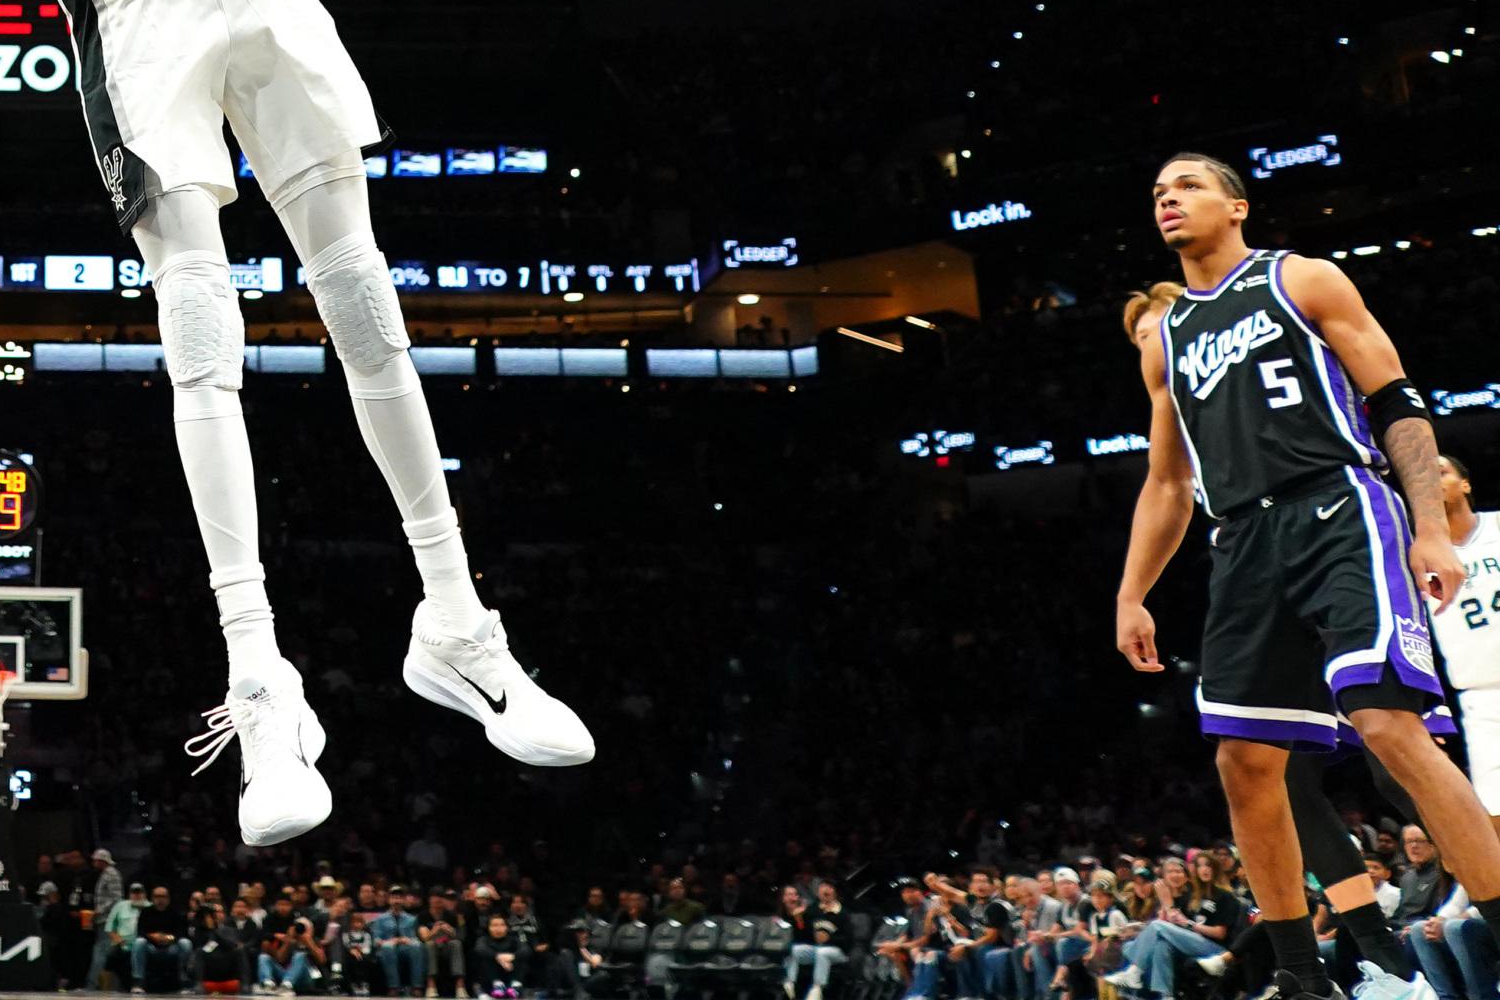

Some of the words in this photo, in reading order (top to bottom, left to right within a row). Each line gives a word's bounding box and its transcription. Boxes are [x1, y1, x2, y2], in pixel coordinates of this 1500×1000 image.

[1263, 144, 1328, 170] LEDGER
[952, 209, 1005, 231] Lock
[1004, 200, 1031, 221] in.
[734, 246, 788, 261] LEDGER
[73, 263, 86, 284] 2
[389, 267, 430, 286] G%
[474, 268, 508, 286] TO
[1178, 309, 1284, 400] Kings
[1259, 358, 1303, 409] 5
